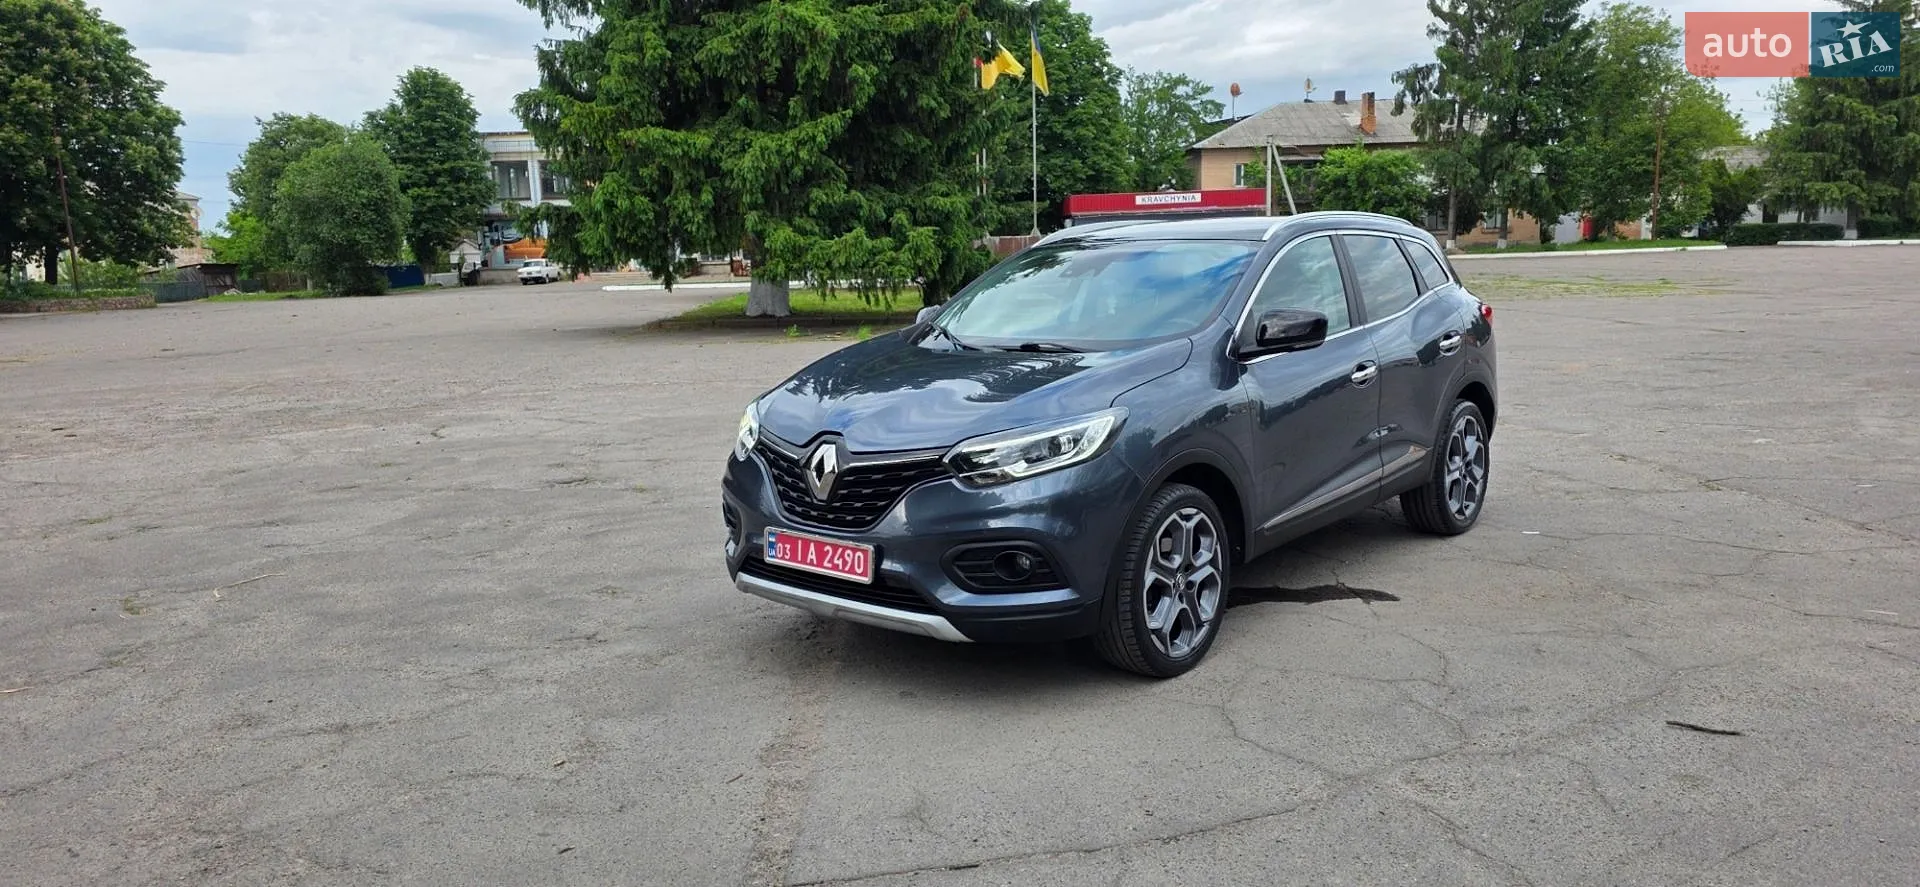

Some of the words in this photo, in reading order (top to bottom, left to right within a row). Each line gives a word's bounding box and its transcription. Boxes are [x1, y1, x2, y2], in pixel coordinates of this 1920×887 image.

[1141, 194, 1197, 203] KRAVCHYNIA
[768, 547, 776, 557] UA
[776, 542, 791, 560] 03
[823, 545, 864, 574] 2490
